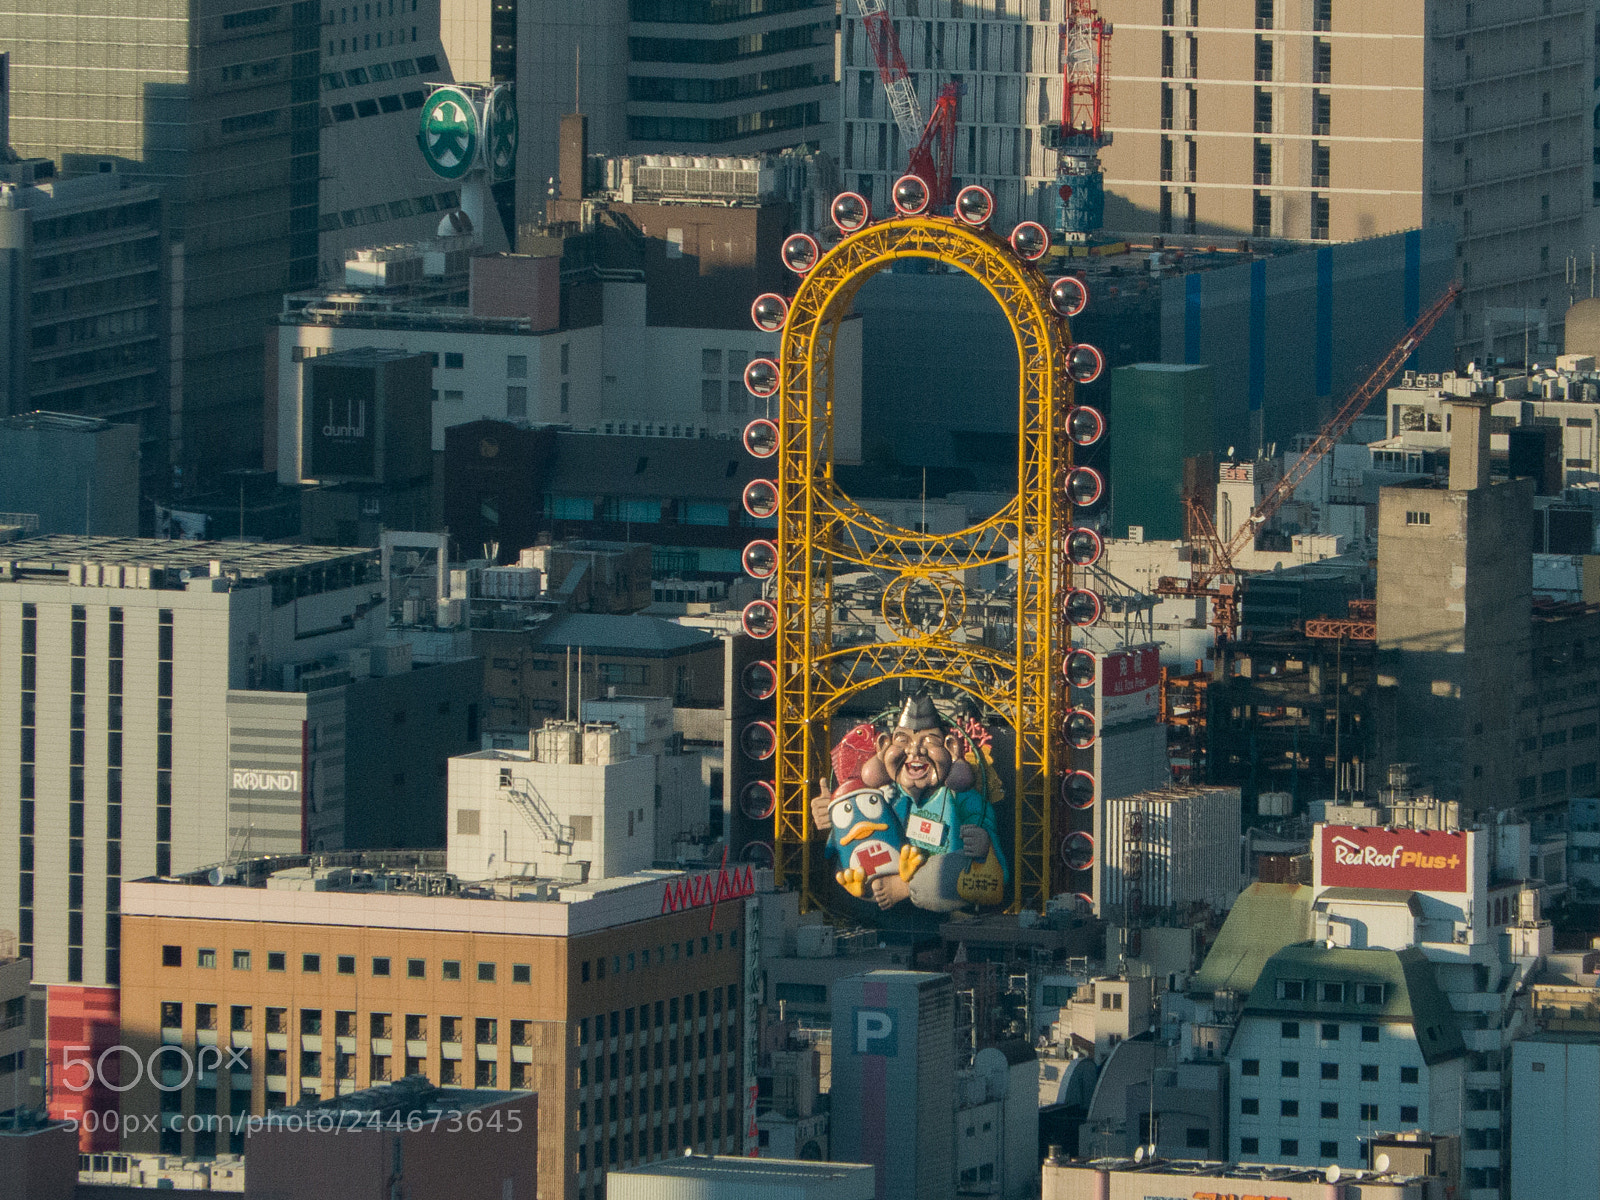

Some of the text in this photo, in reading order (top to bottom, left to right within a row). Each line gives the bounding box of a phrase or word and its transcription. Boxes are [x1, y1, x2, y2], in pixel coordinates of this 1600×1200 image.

[322, 398, 365, 437] dunhill
[233, 770, 298, 792] ROUND1
[1400, 851, 1460, 869] Plus+
[857, 1011, 893, 1052] P
